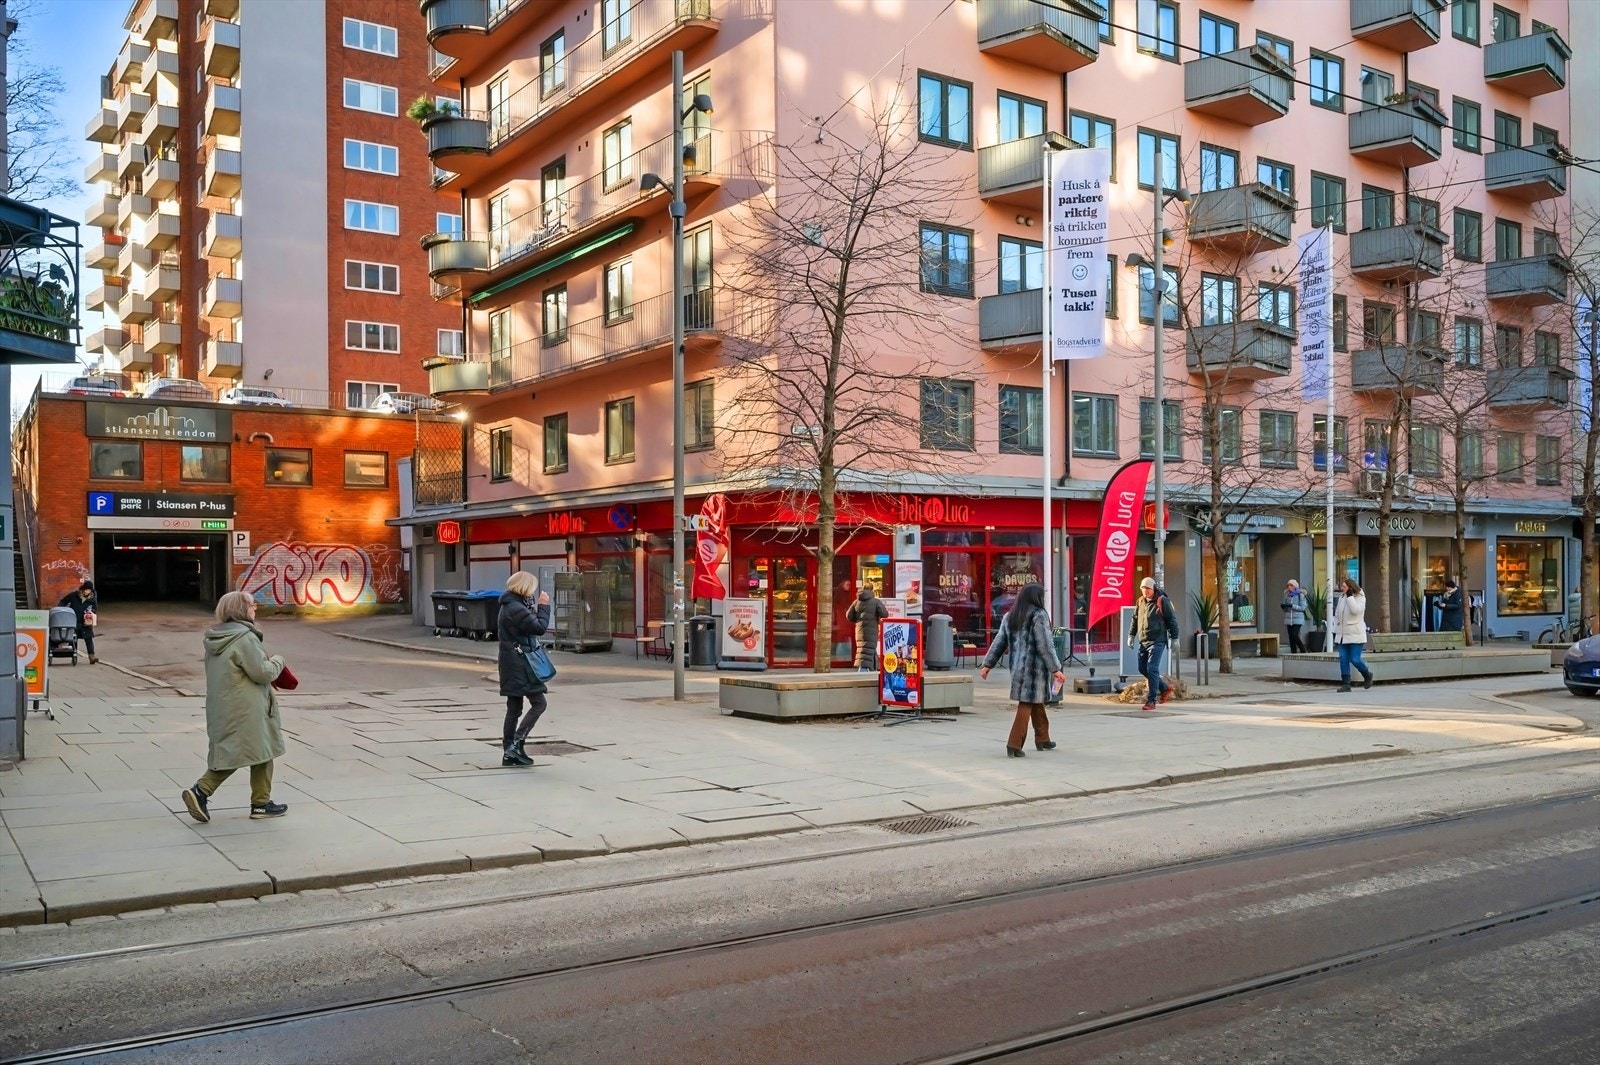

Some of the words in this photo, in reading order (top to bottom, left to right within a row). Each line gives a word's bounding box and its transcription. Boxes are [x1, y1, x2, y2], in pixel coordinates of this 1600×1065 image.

[1062, 180, 1091, 191] Husk
[1093, 179, 1101, 190] å
[1058, 193, 1104, 207] parkere
[1064, 206, 1098, 219] riktig
[1053, 222, 1066, 233] så
[1068, 221, 1107, 232] trikken
[1057, 236, 1104, 246] kommer
[1067, 249, 1094, 259] frem
[1061, 288, 1097, 298] Tusen
[1064, 301, 1094, 312] takk!
[105, 425, 159, 436] stiansen
[164, 428, 216, 438] eiendom
[96, 498, 107, 511] P
[156, 499, 197, 510] Stiansen
[199, 500, 226, 511] P-hus
[900, 495, 922, 522] Deli
[945, 496, 969, 523] Luca
[1108, 491, 1137, 528] Luca
[236, 533, 246, 545] P
[442, 525, 457, 540] deli
[1105, 537, 1130, 557] de
[939, 574, 969, 587] DELI'S
[1004, 574, 1038, 586] DAWGS
[1097, 566, 1126, 599] Deli
[938, 587, 968, 595] KITCHEN
[884, 630, 905, 651] KUPP!
